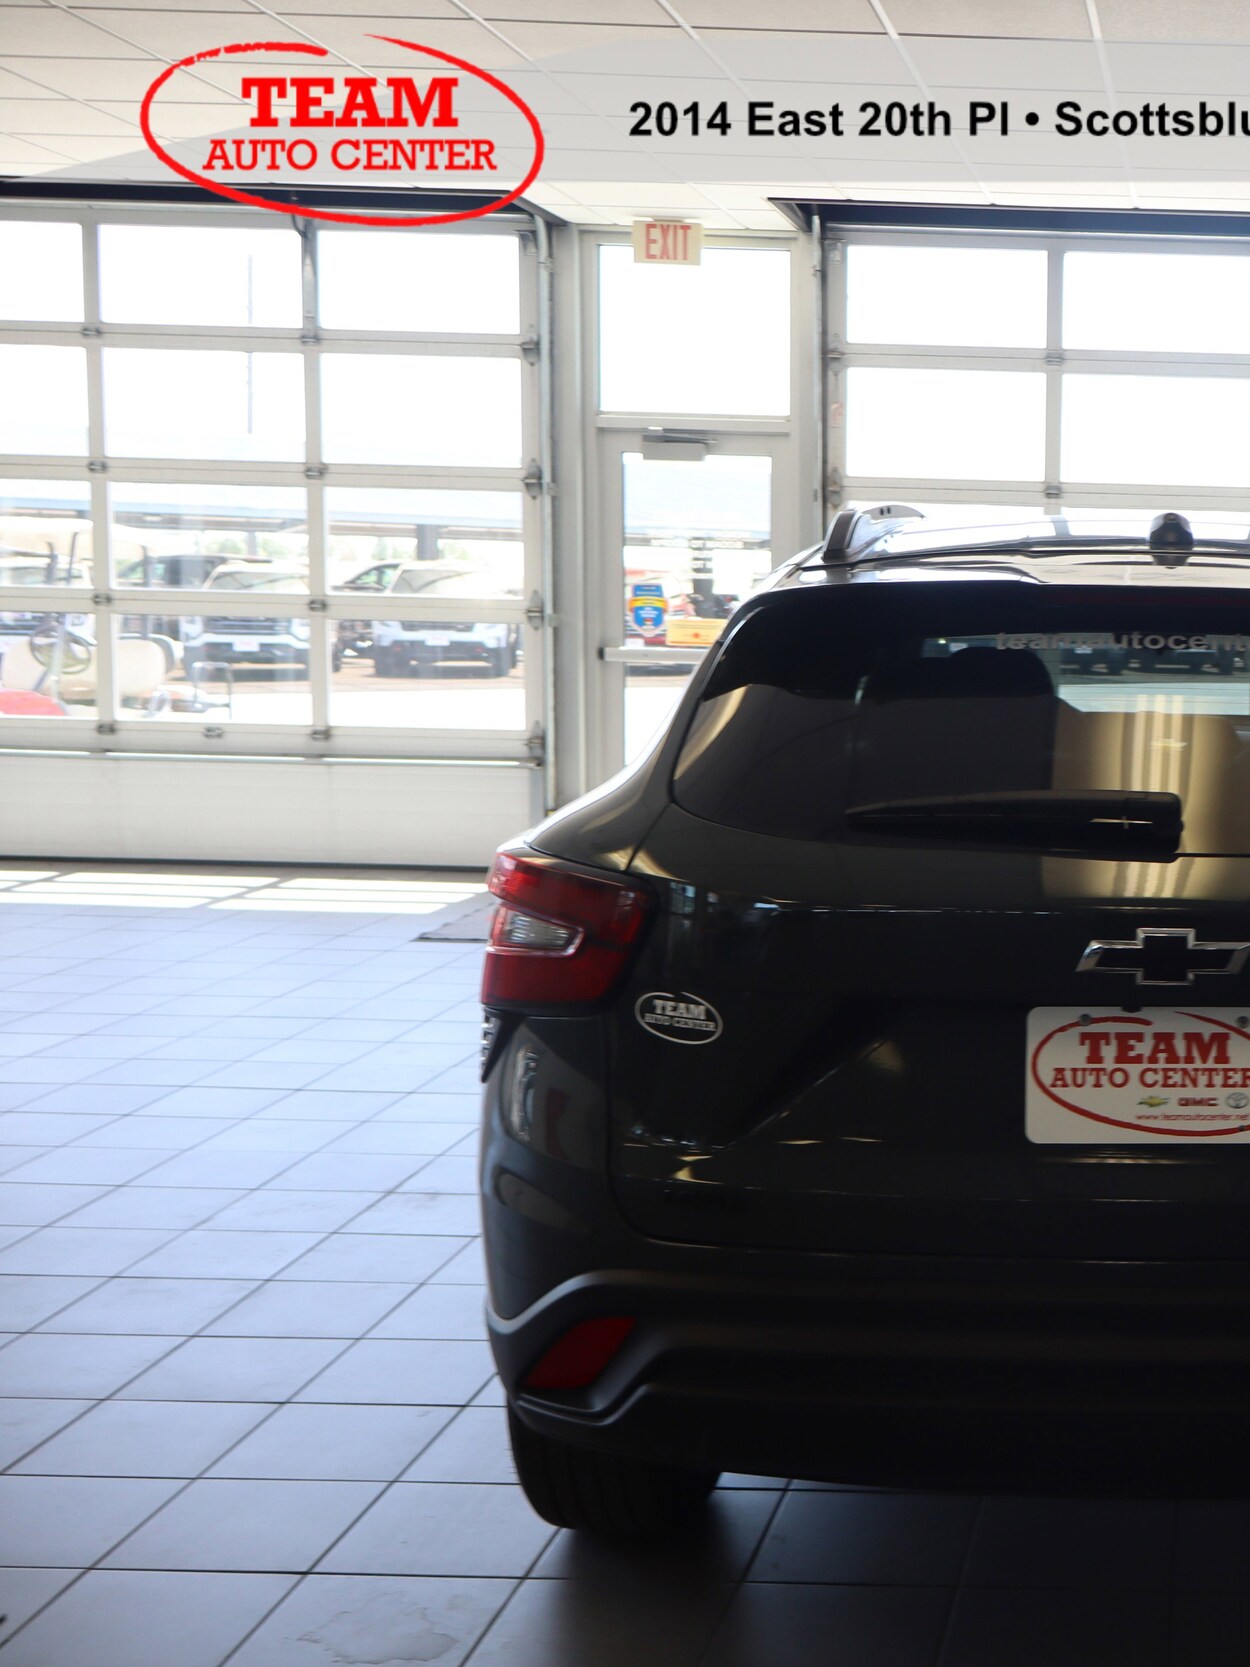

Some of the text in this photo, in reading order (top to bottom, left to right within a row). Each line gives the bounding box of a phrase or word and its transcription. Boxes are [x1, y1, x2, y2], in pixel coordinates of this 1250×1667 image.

[645, 223, 692, 260] EXIT
[653, 999, 707, 1020] TEAM
[1079, 1031, 1231, 1065] TEAM
[1050, 1067, 1130, 1089] AUTO
[1176, 1097, 1219, 1107] GMC
